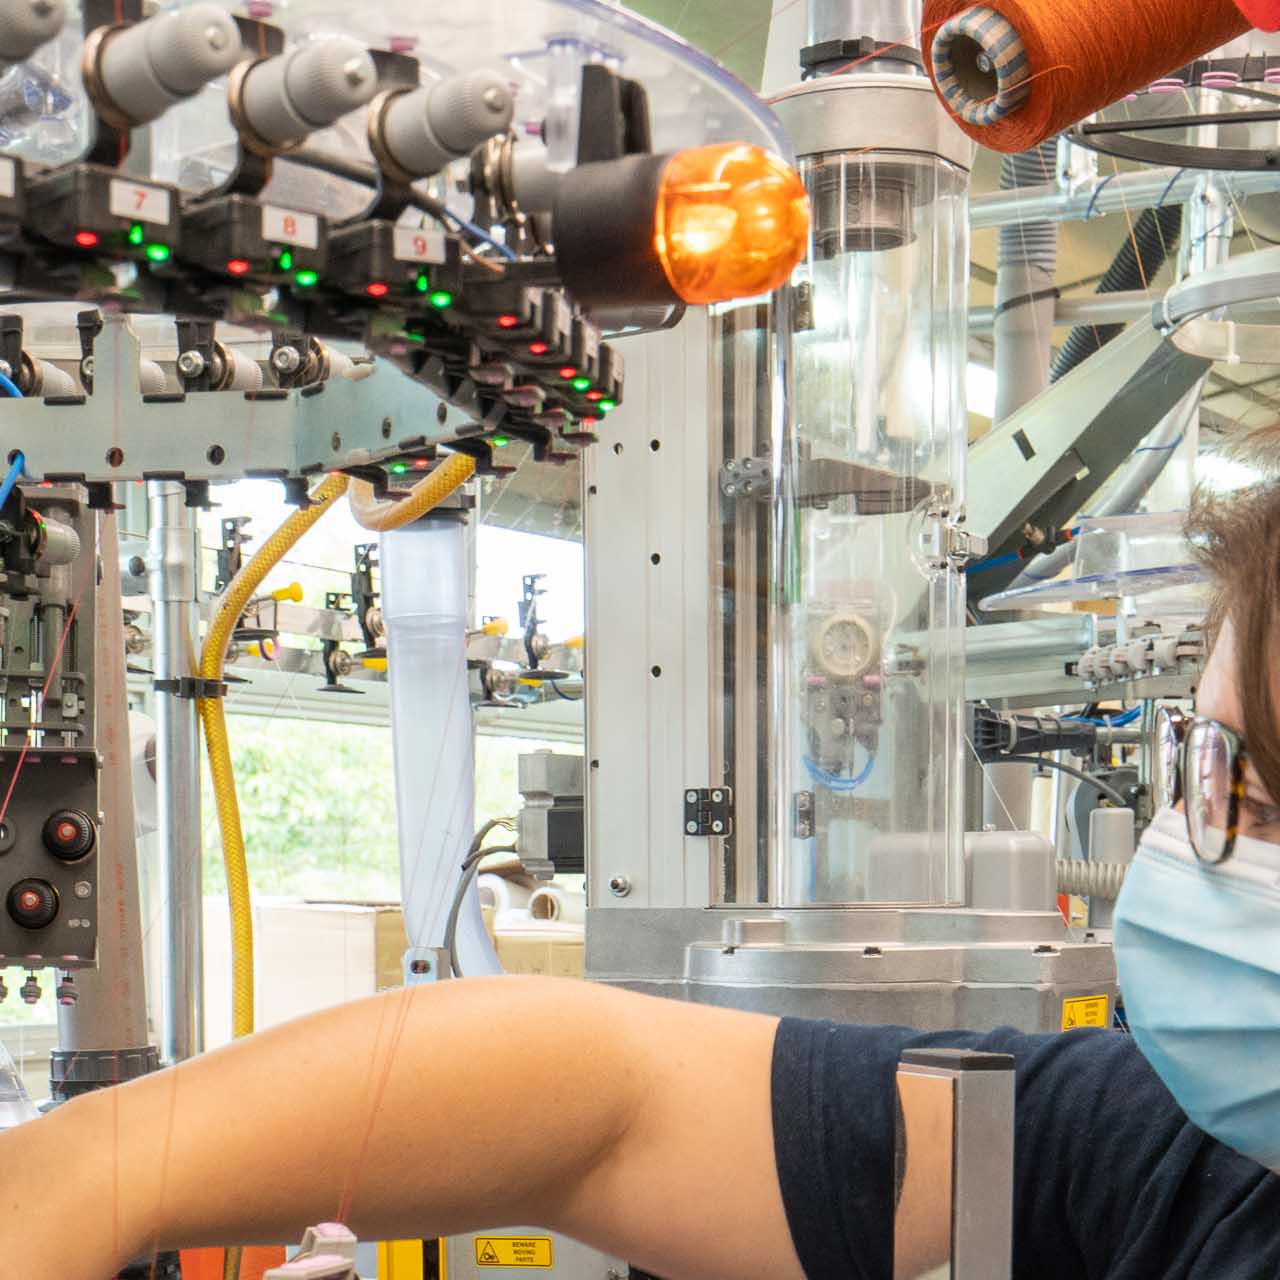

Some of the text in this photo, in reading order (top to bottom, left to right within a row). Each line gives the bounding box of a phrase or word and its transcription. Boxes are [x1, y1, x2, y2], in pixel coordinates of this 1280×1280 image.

[134, 192, 147, 210] 7
[283, 215, 297, 236] 8
[413, 236, 427, 256] 9
